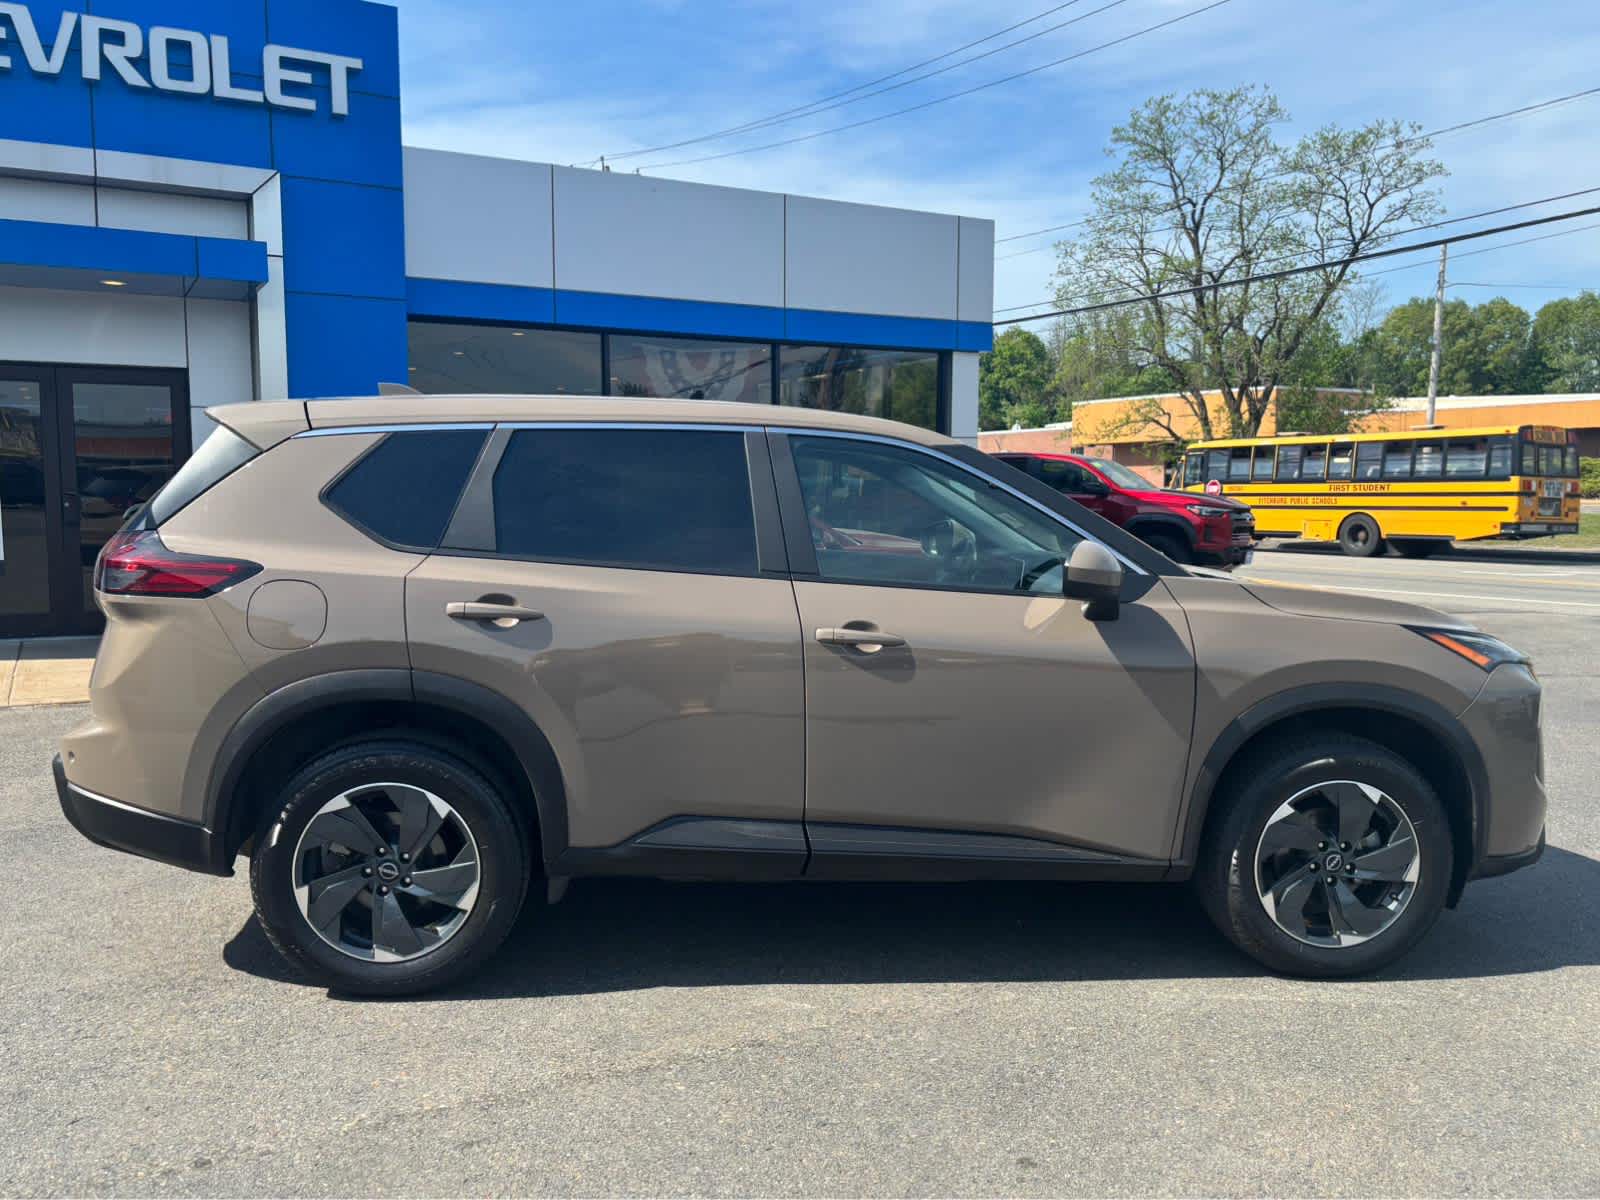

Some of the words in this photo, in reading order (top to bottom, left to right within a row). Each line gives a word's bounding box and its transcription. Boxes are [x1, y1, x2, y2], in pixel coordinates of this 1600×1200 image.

[0, 0, 363, 116] VROLET
[1329, 484, 1350, 492] FIRST
[1352, 484, 1391, 492] STUDENT
[1290, 496, 1309, 504] PUBLIC
[1311, 496, 1338, 504] SCHOOLS
